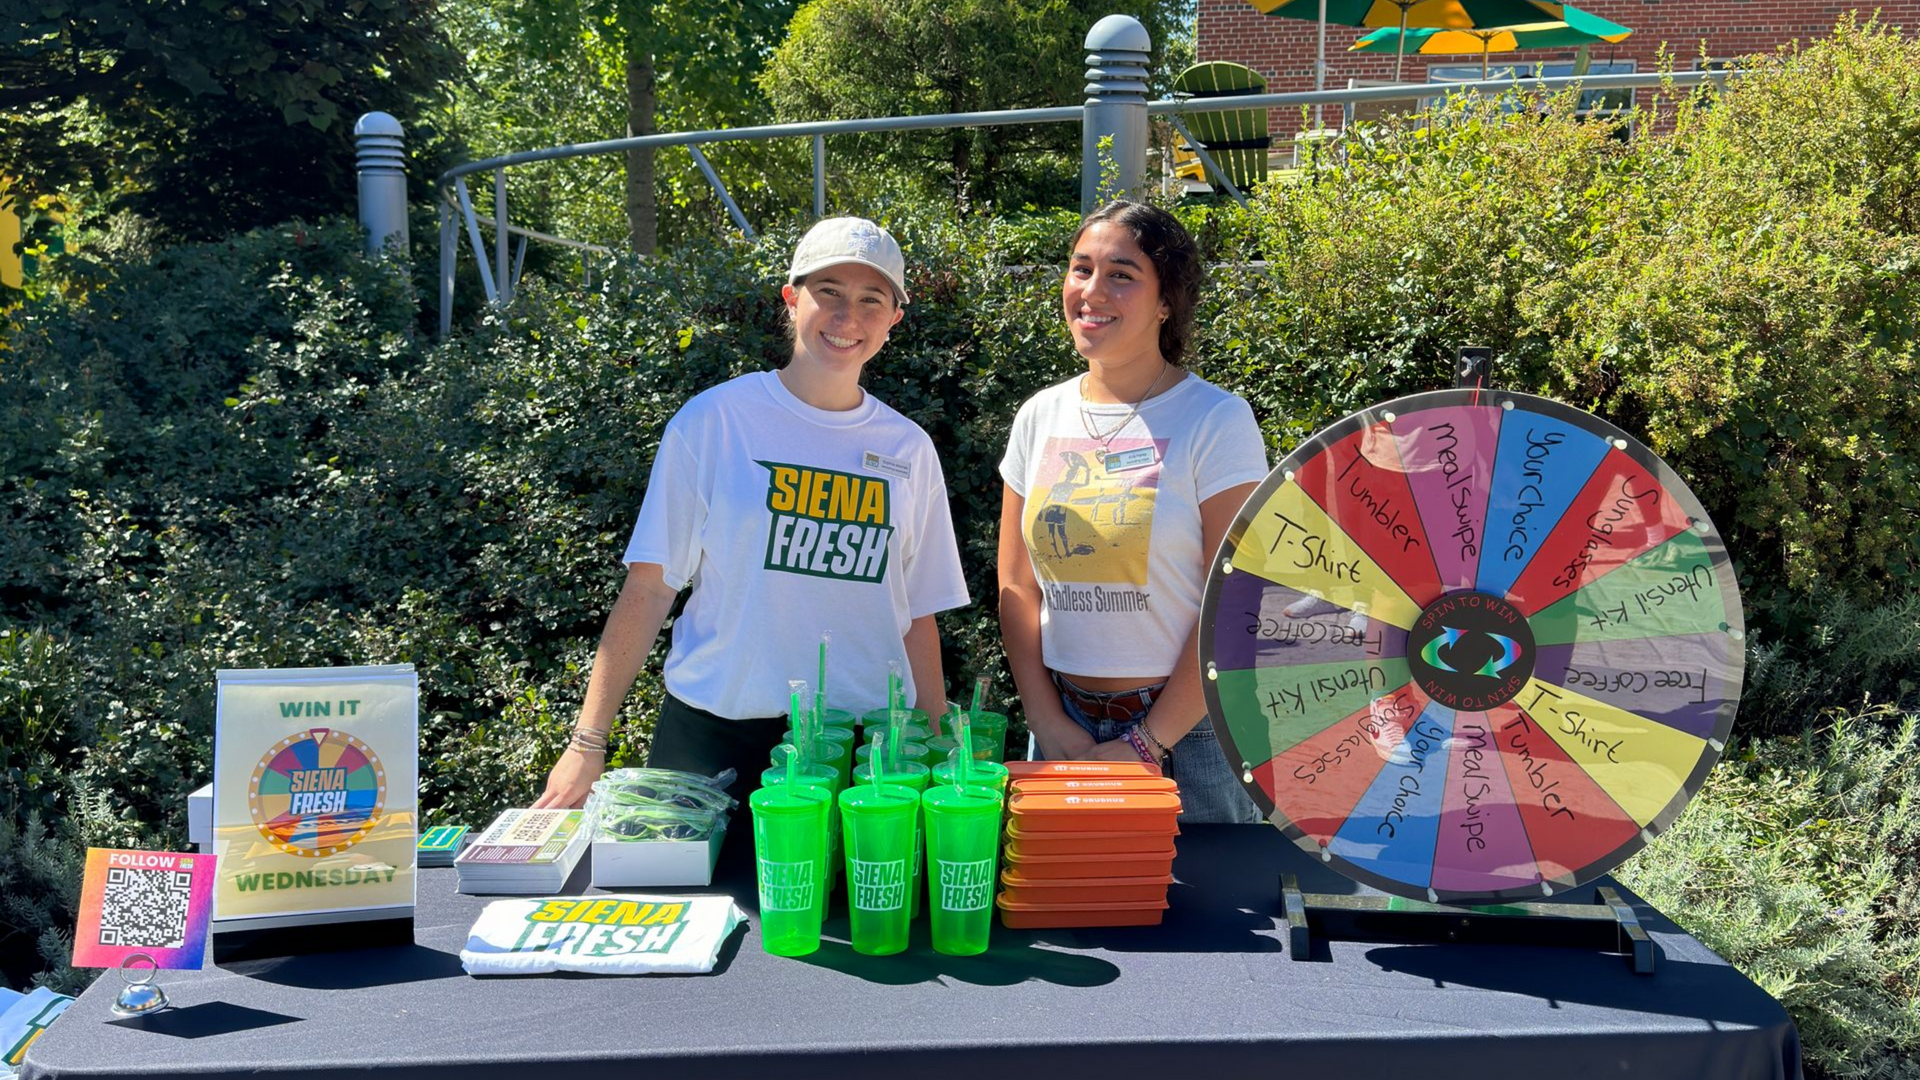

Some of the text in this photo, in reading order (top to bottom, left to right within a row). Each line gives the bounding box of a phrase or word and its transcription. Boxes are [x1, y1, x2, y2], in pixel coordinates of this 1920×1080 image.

[772, 466, 885, 524] SIENA
[1337, 444, 1420, 552] Tumbler
[771, 514, 890, 578] FRESH
[1553, 475, 1659, 588] Sunglasses
[1269, 512, 1361, 583] T-Shirt
[1051, 584, 1093, 612] Endless
[1423, 596, 1518, 629] SPIN TO WIN
[1590, 564, 1713, 631] Utensil Kit
[1330, 624, 1383, 655] Free
[1266, 666, 1386, 718] Utensil Kit
[1425, 676, 1521, 708] SPIN TO WIN
[1654, 668, 1707, 704] Free
[280, 700, 361, 718] WIN IT
[1528, 684, 1624, 764] T-Shirt
[1293, 693, 1415, 784] Sunglasses
[291, 769, 345, 792] SIENA
[1504, 712, 1575, 820] Tumbler
[291, 790, 347, 814] FRESH
[109, 853, 175, 868] FOLLOW
[763, 861, 813, 886] SIENA
[854, 861, 904, 886] SIENA
[942, 860, 990, 885] SIENA
[236, 865, 397, 892] WEDNESDAY
[764, 885, 813, 909] FRESH
[856, 885, 904, 909] FRESH
[945, 884, 990, 909] FRESH
[532, 900, 685, 925] SIENA
[525, 922, 678, 955] FRESH
